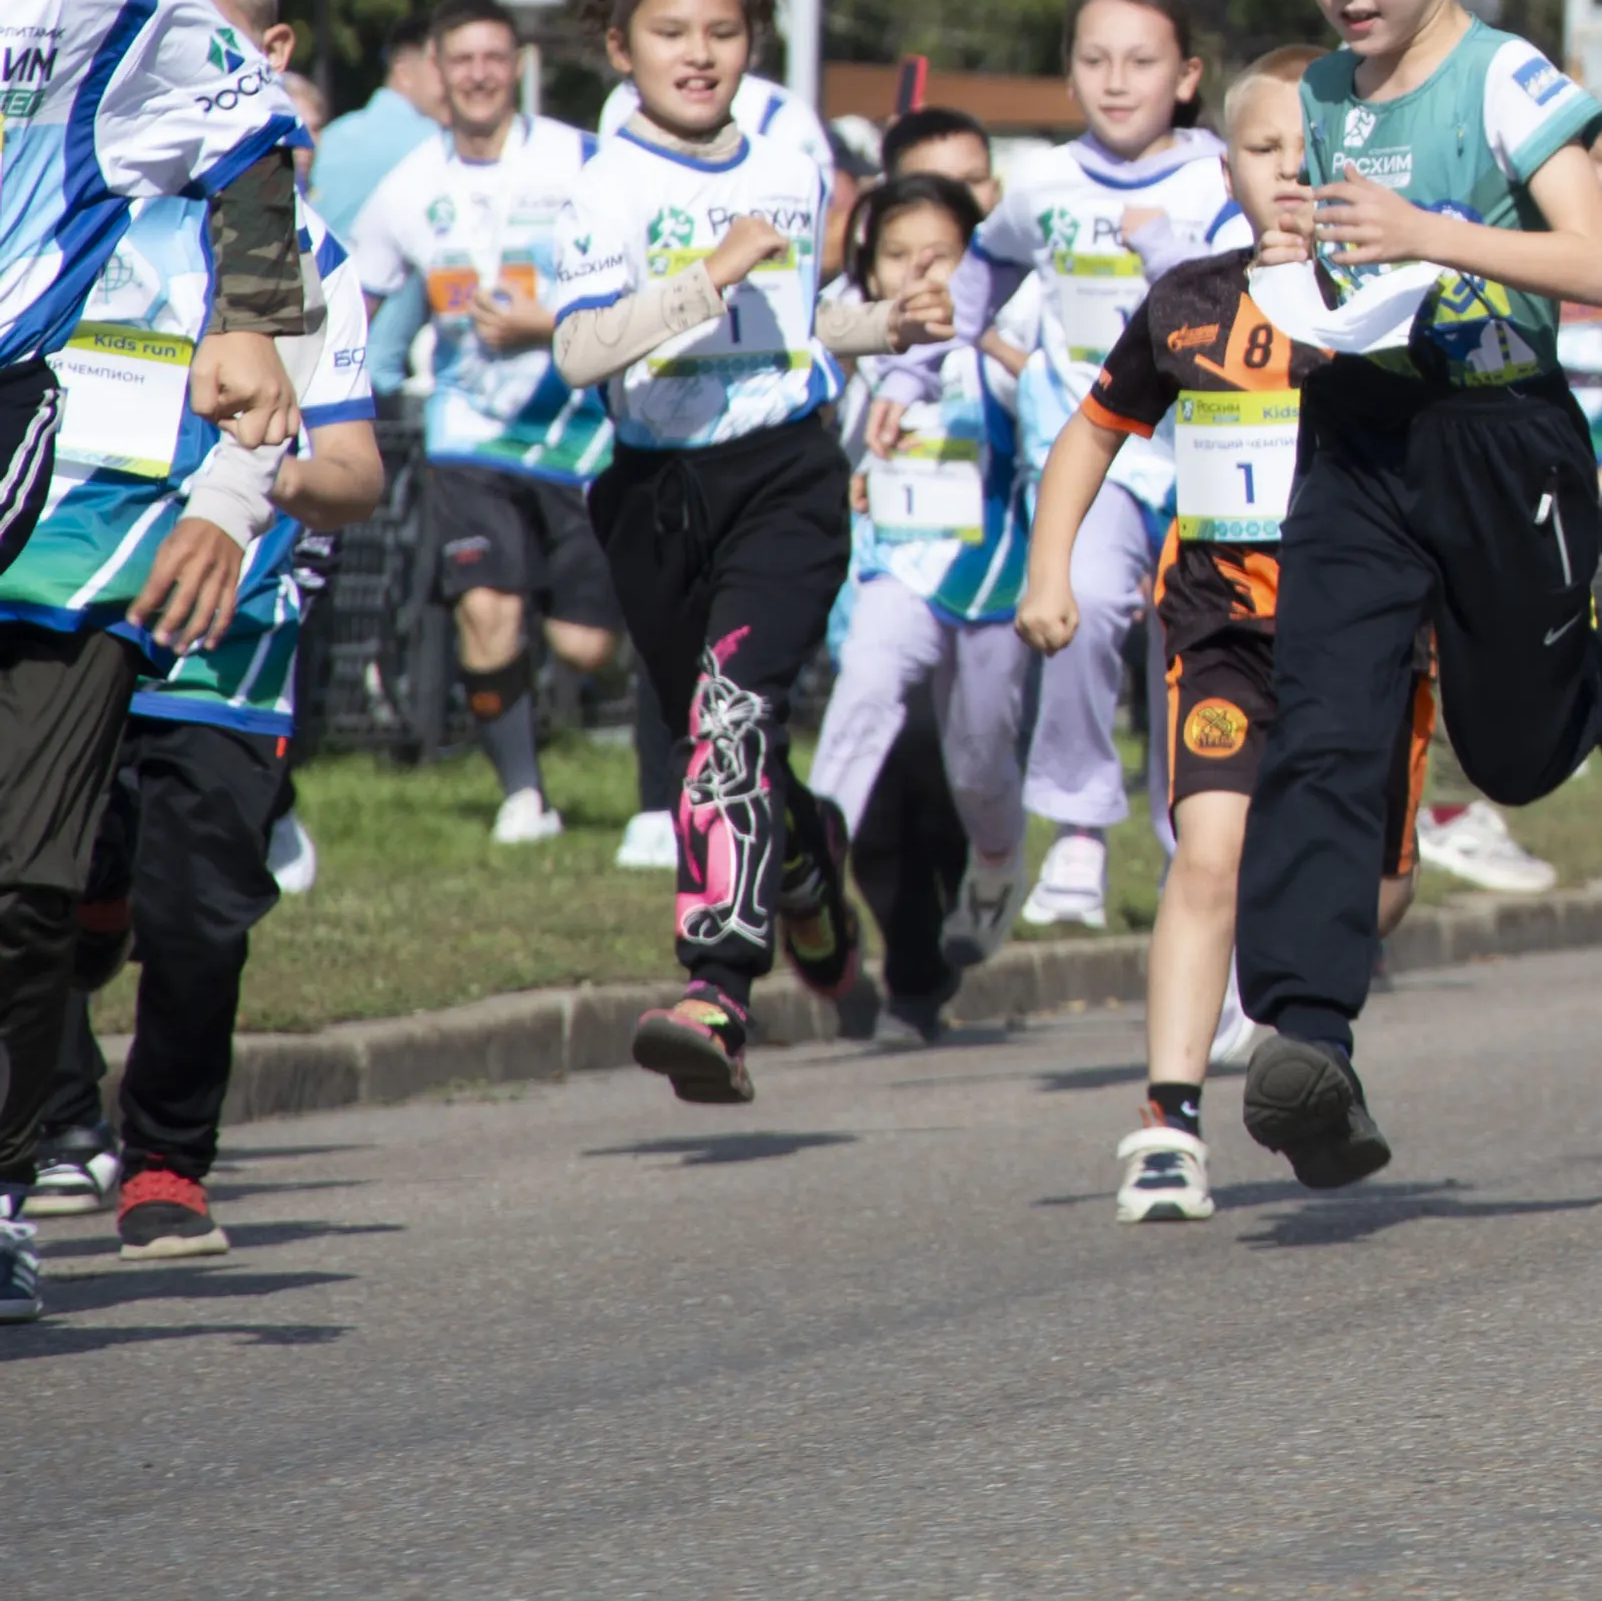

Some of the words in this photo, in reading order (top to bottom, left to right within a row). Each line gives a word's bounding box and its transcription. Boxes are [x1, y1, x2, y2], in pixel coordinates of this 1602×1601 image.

[728, 304, 742, 344] 1
[93, 333, 137, 351] Kids
[142, 343, 177, 358] run
[1244, 322, 1274, 369] 8
[68, 361, 146, 384] ЧЕМПИОН
[1262, 406, 1299, 419] Kids
[1236, 462, 1255, 504] 1
[903, 484, 914, 515] 1
